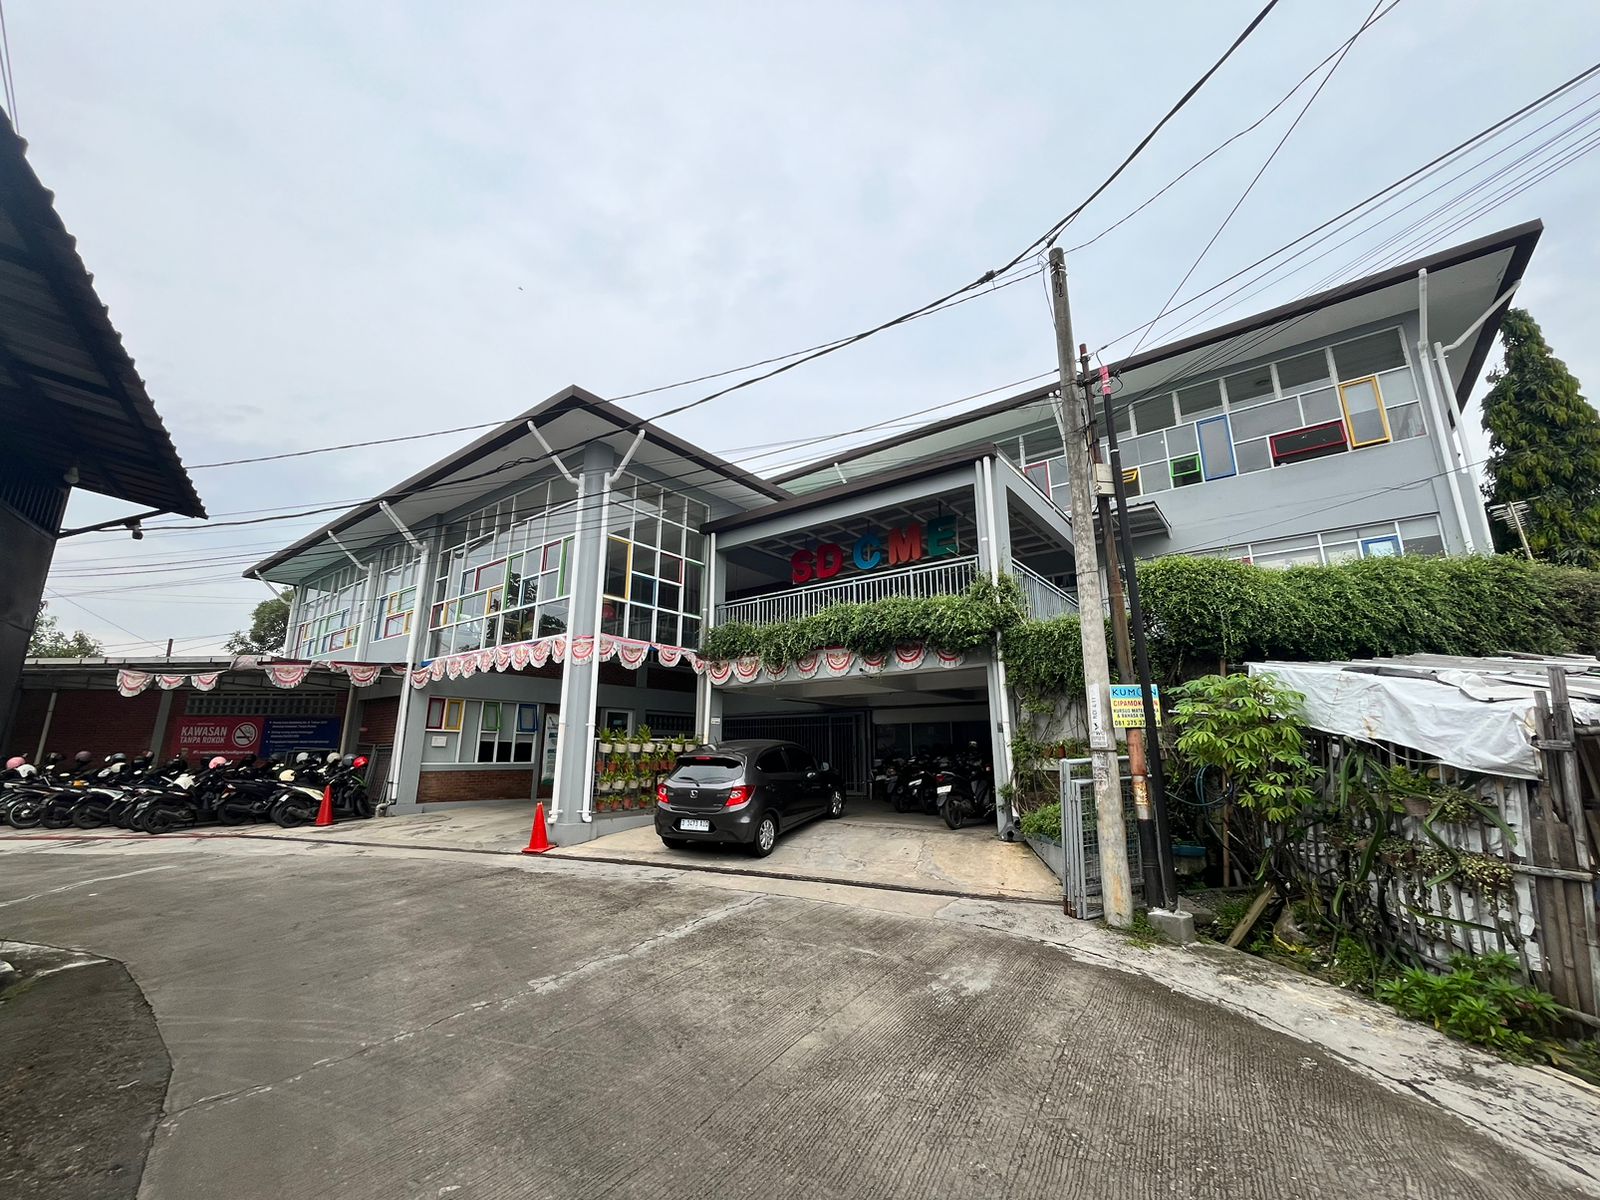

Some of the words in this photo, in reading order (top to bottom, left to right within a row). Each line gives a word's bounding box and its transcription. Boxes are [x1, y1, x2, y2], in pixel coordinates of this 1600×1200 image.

[790, 543, 844, 584] SD
[853, 515, 957, 570] CME
[180, 726, 228, 737] KAWASAN
